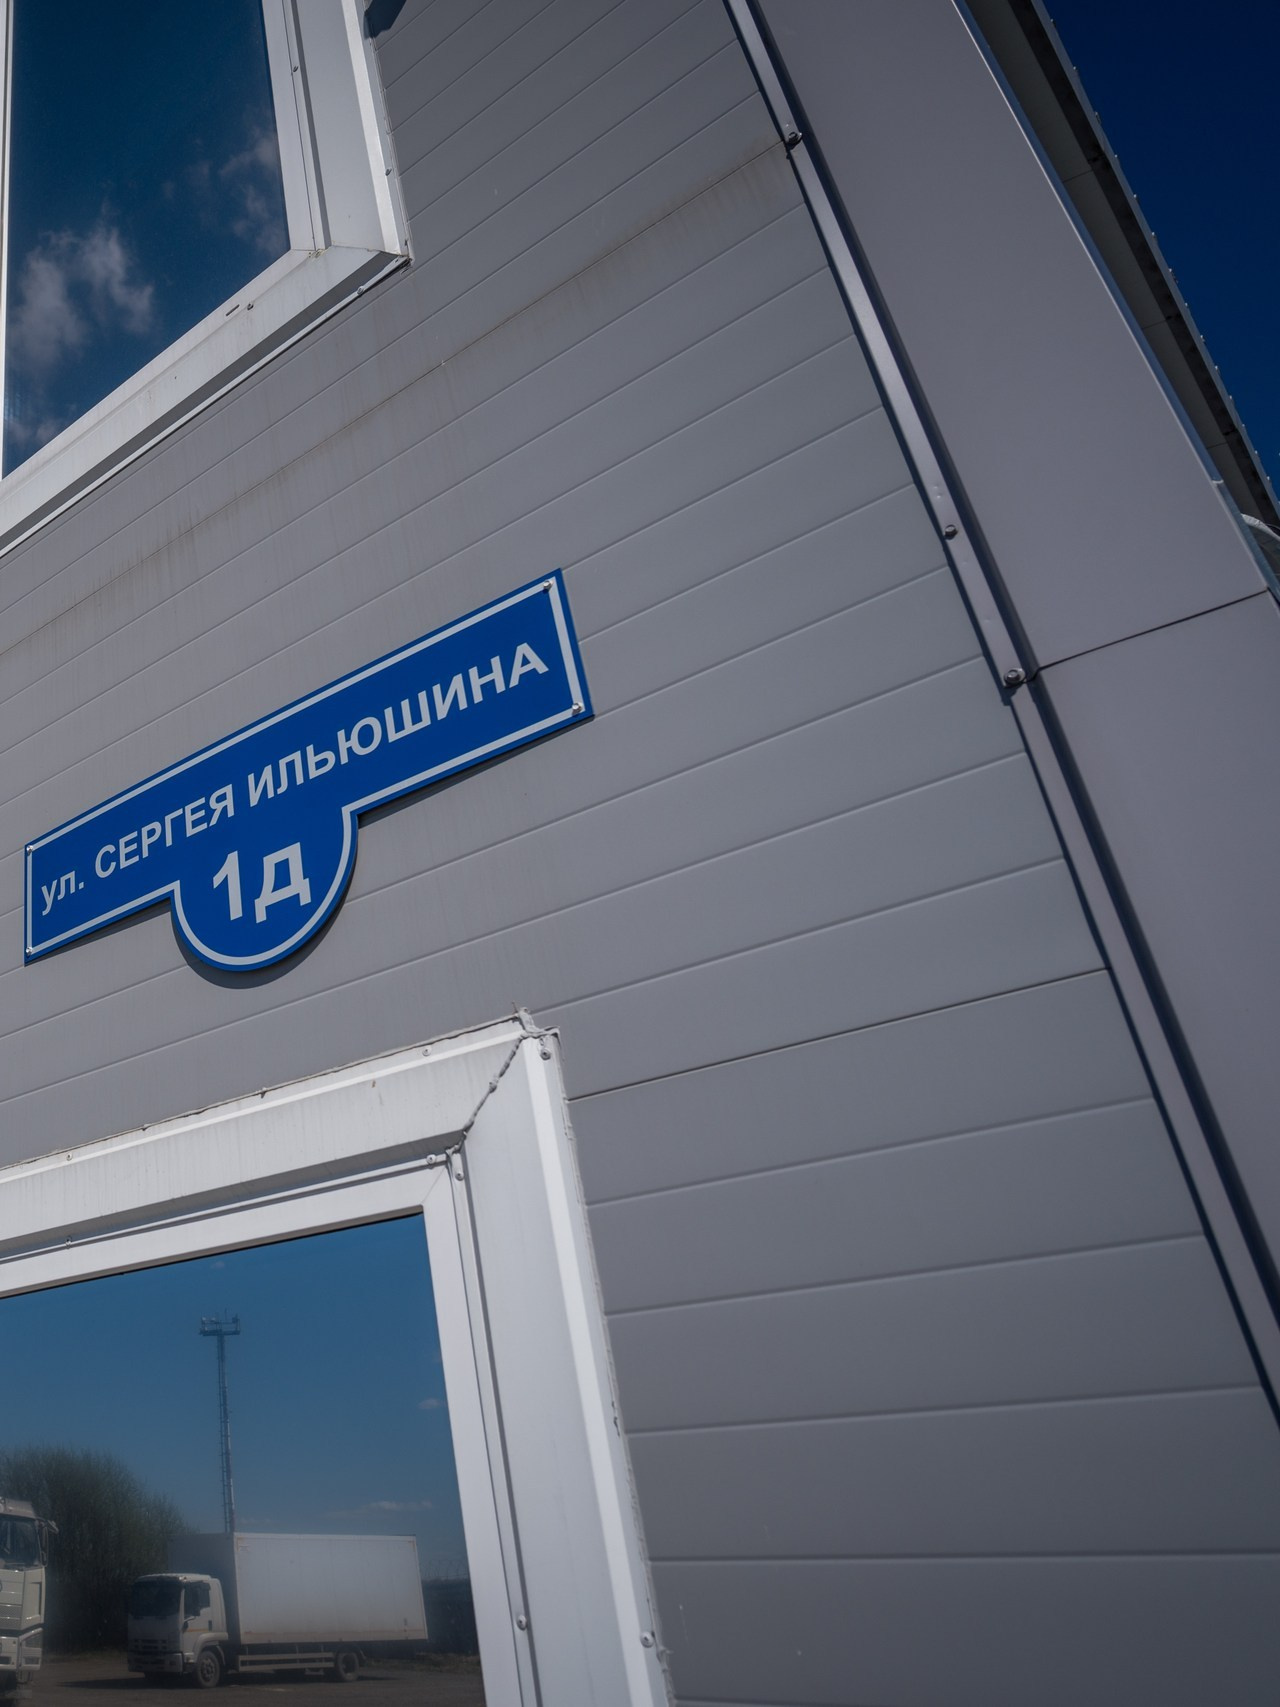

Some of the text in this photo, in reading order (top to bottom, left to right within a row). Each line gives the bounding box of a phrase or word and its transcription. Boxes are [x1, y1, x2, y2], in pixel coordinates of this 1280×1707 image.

[41, 642, 549, 916] ул. СЕРГЕЯ ИЛЬЮШИНА
